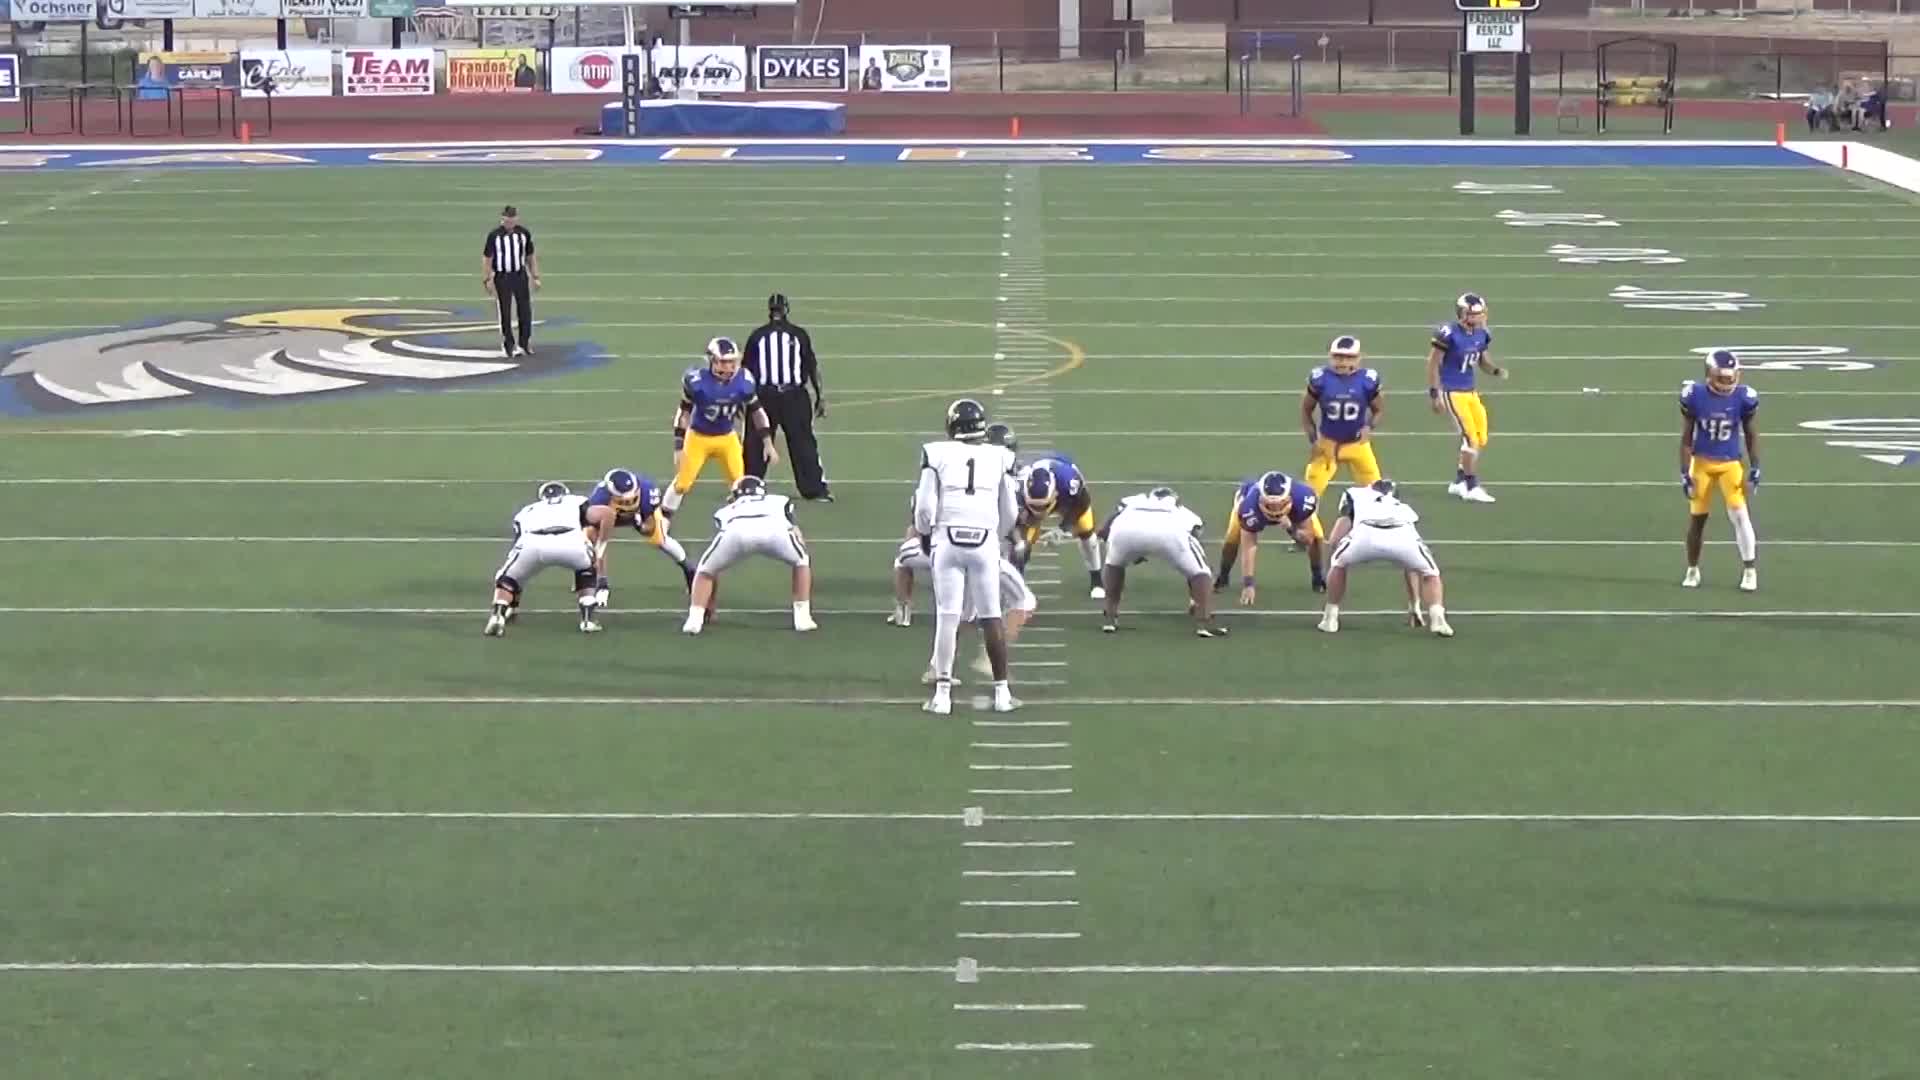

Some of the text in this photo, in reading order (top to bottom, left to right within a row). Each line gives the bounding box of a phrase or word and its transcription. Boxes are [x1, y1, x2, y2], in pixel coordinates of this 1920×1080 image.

[1476, 25, 1514, 36] RENTALS
[345, 52, 430, 75] TEAM
[763, 58, 840, 78] DYKES
[1327, 401, 1360, 421] 30
[1701, 419, 1732, 442] 46
[965, 457, 977, 496] 1
